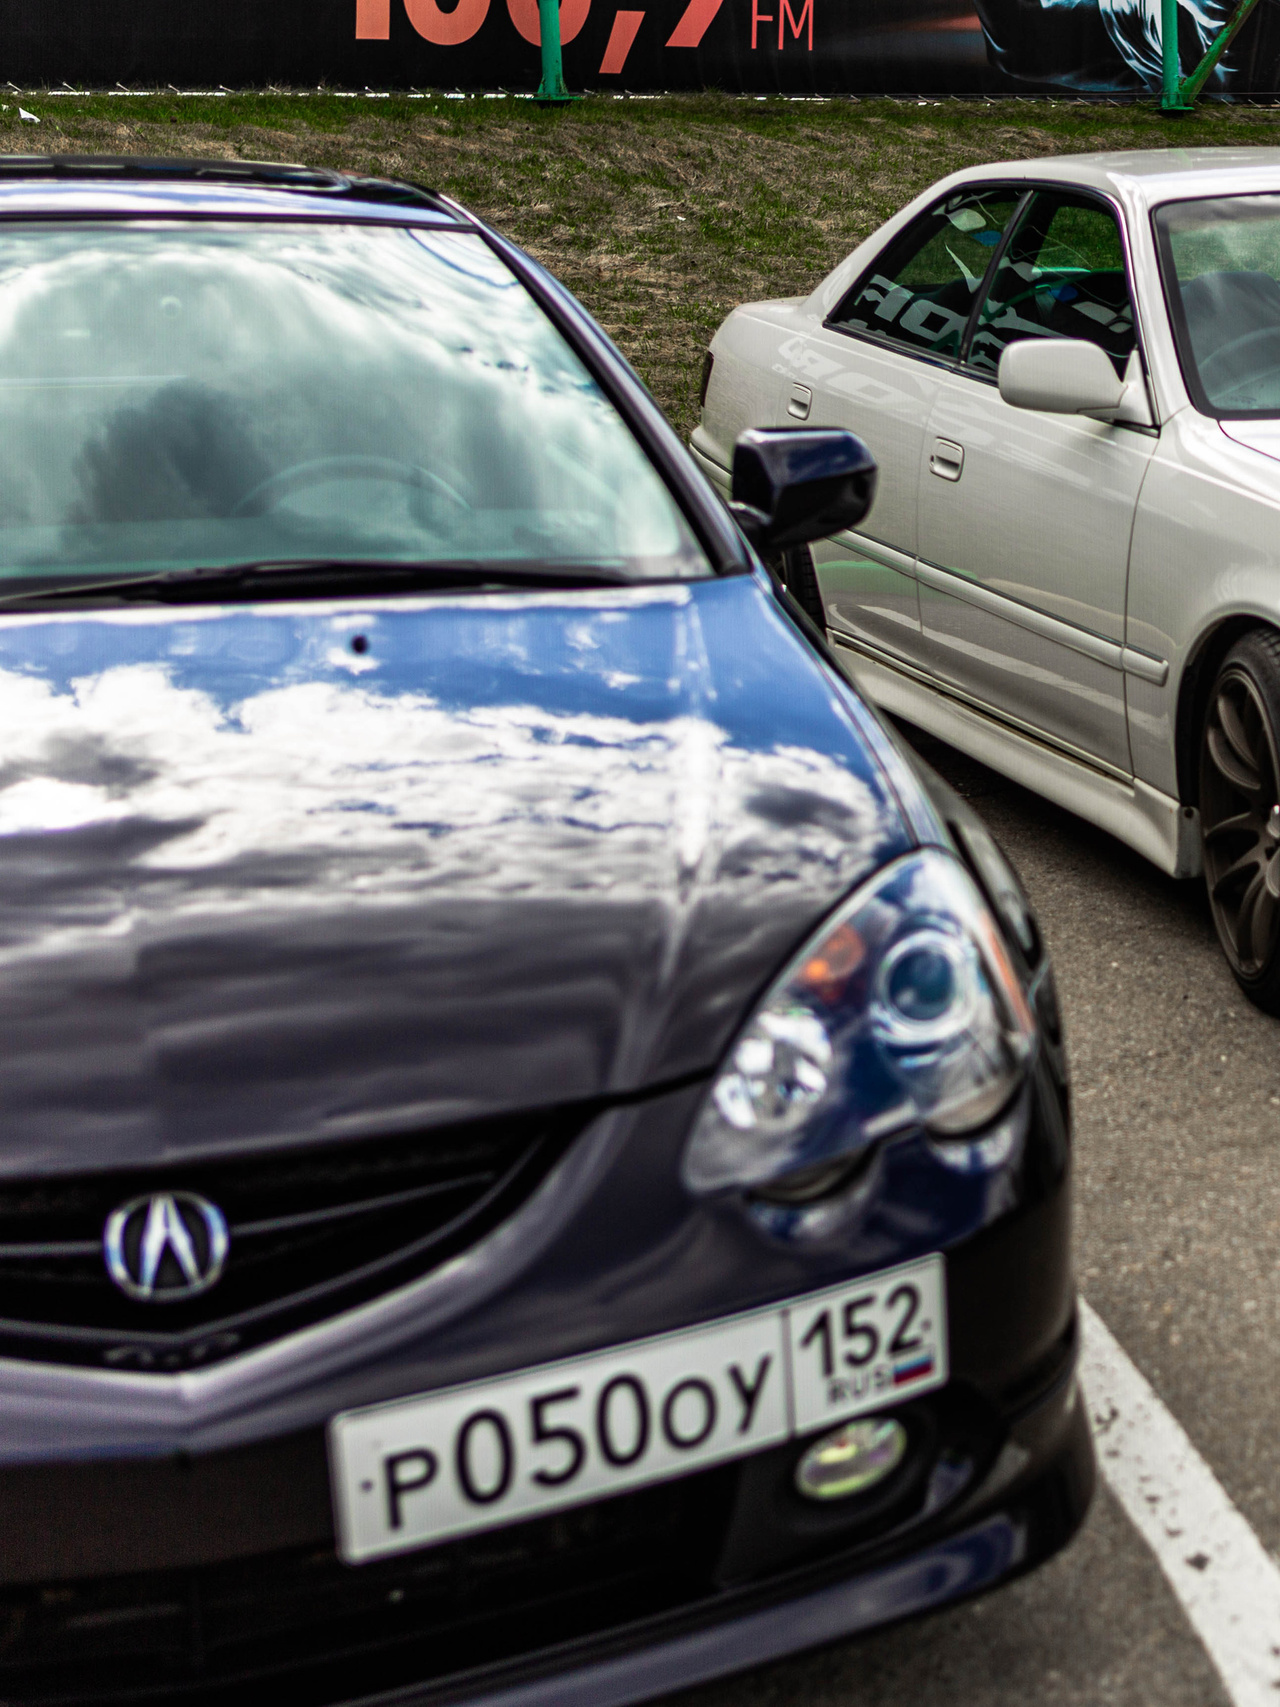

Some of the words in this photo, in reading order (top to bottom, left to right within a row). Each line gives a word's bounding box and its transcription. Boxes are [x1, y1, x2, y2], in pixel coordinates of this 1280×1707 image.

[751, 0, 814, 51] FM
[801, 1283, 922, 1378] 152
[826, 1364, 892, 1404] RUS
